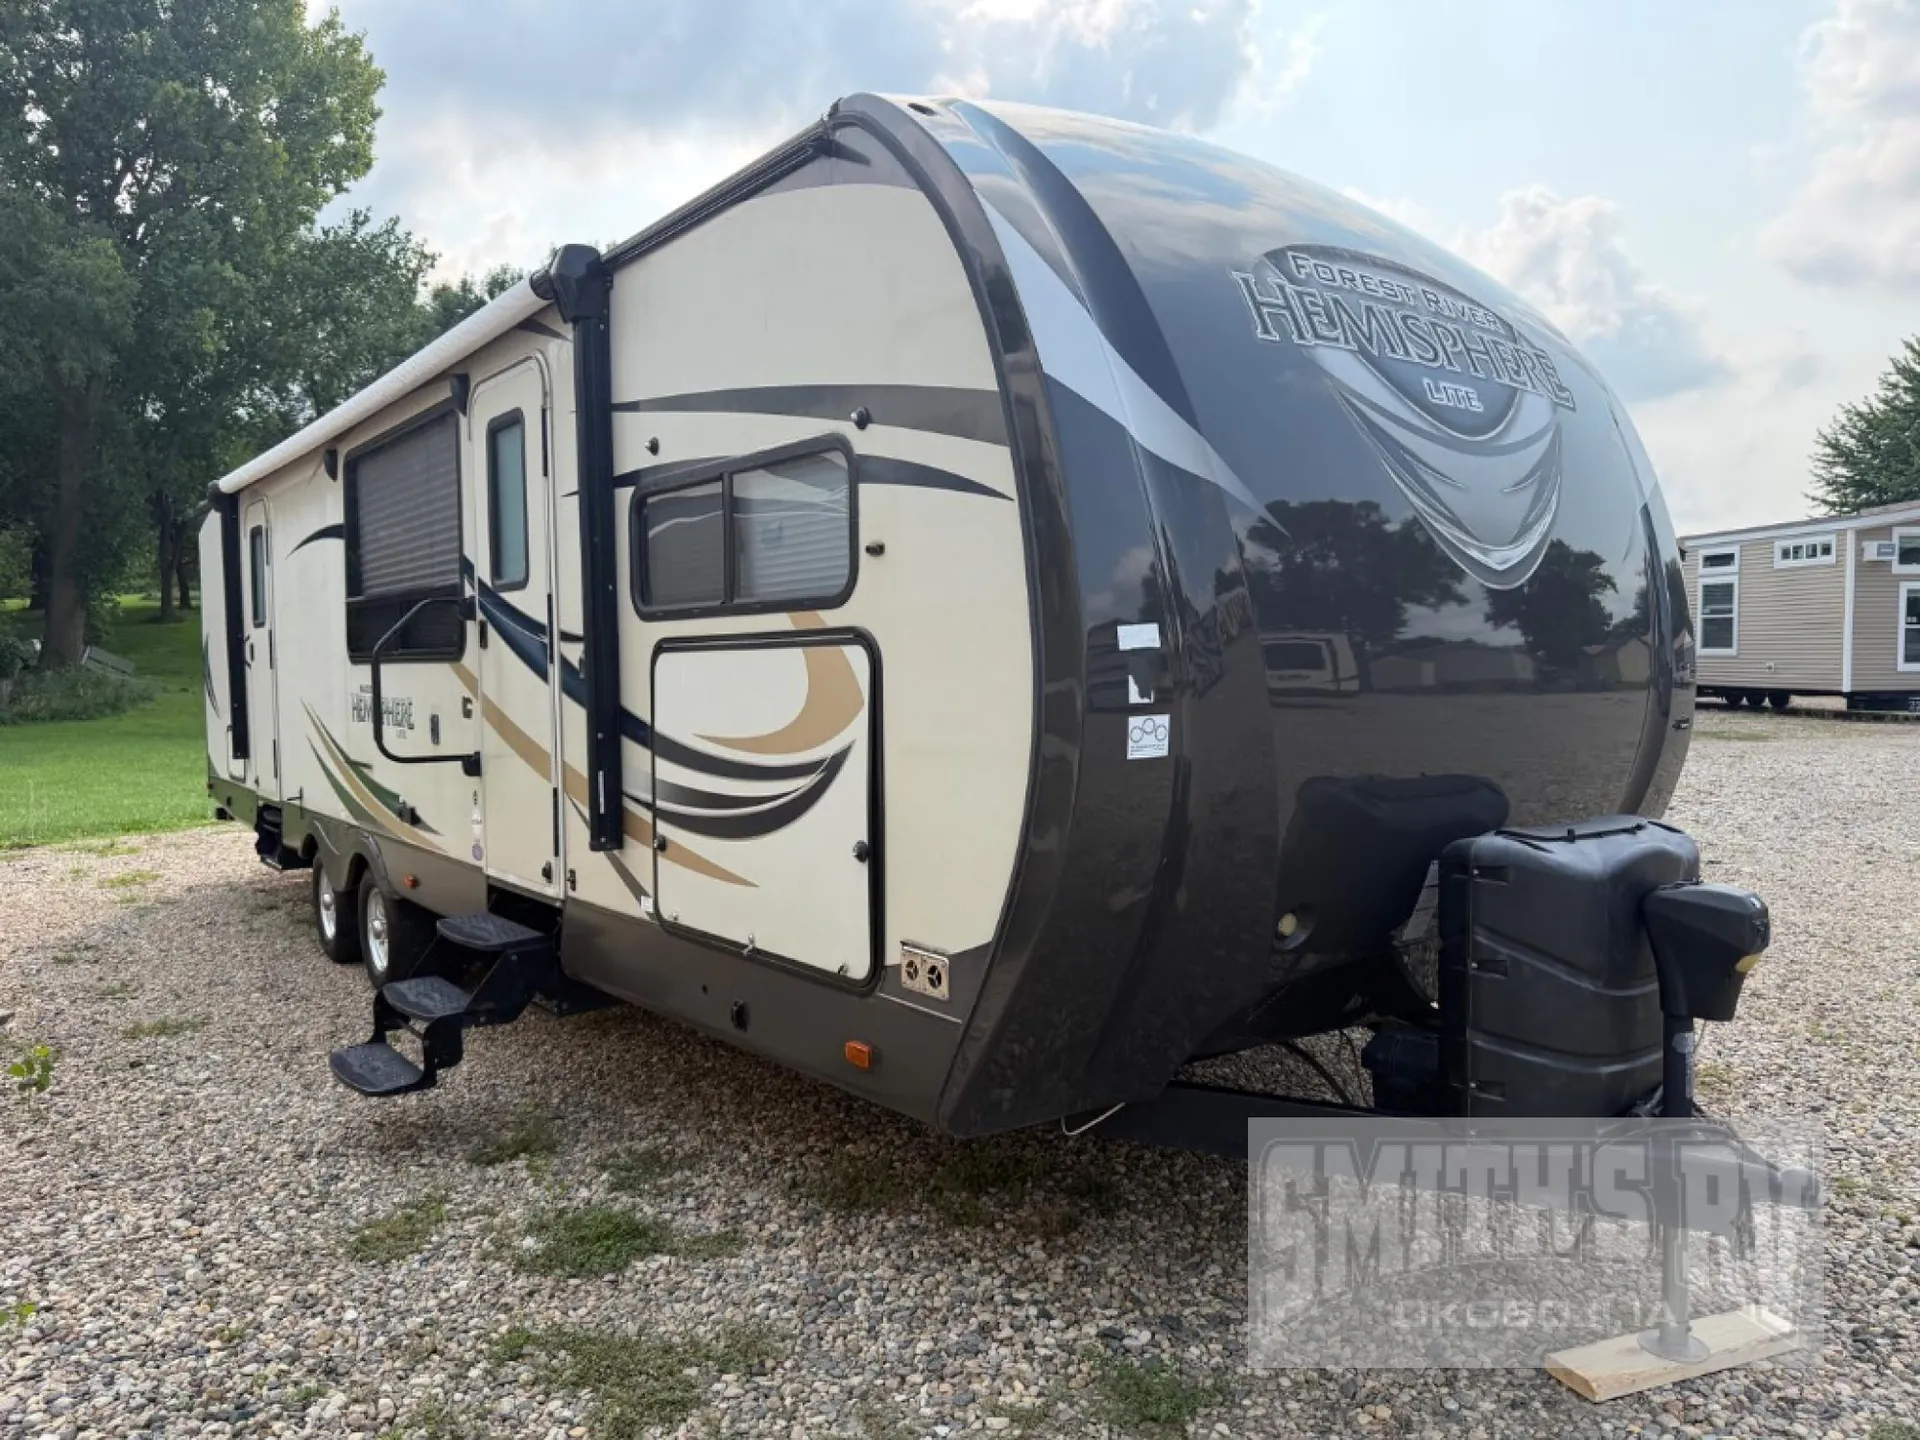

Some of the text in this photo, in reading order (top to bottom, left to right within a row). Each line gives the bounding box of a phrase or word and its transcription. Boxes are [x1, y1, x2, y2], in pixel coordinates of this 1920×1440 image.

[1287, 250, 1503, 330] FOREST RIVER
[1230, 270, 1576, 412] HEMISPHERE
[1421, 376, 1484, 412] LITE
